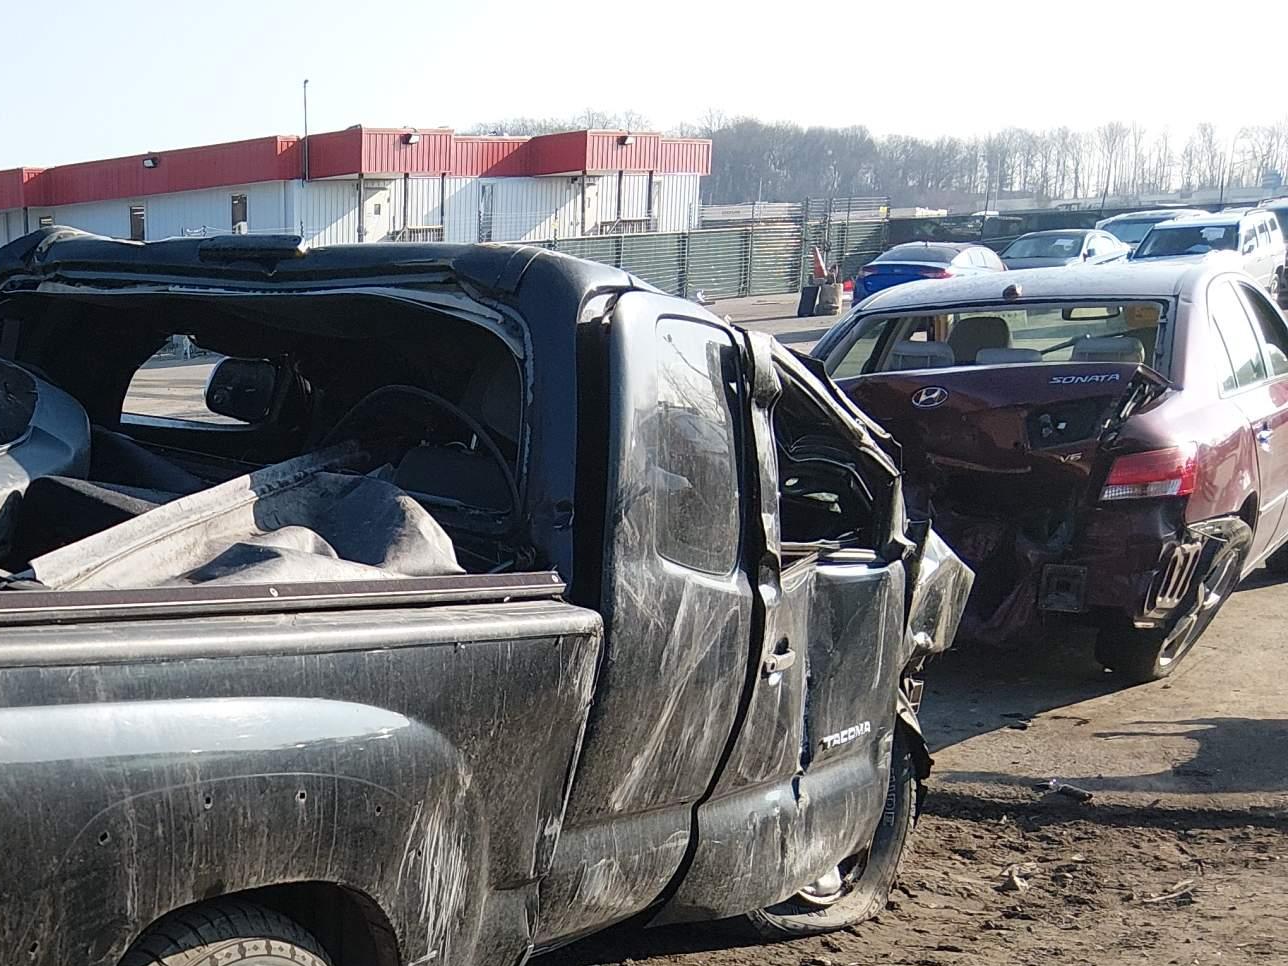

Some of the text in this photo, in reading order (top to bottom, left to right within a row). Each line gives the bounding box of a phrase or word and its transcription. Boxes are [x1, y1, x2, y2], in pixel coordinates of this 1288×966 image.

[1049, 373, 1120, 384] SONATA
[1060, 452, 1082, 463] V6
[823, 721, 871, 749] TACOMA
